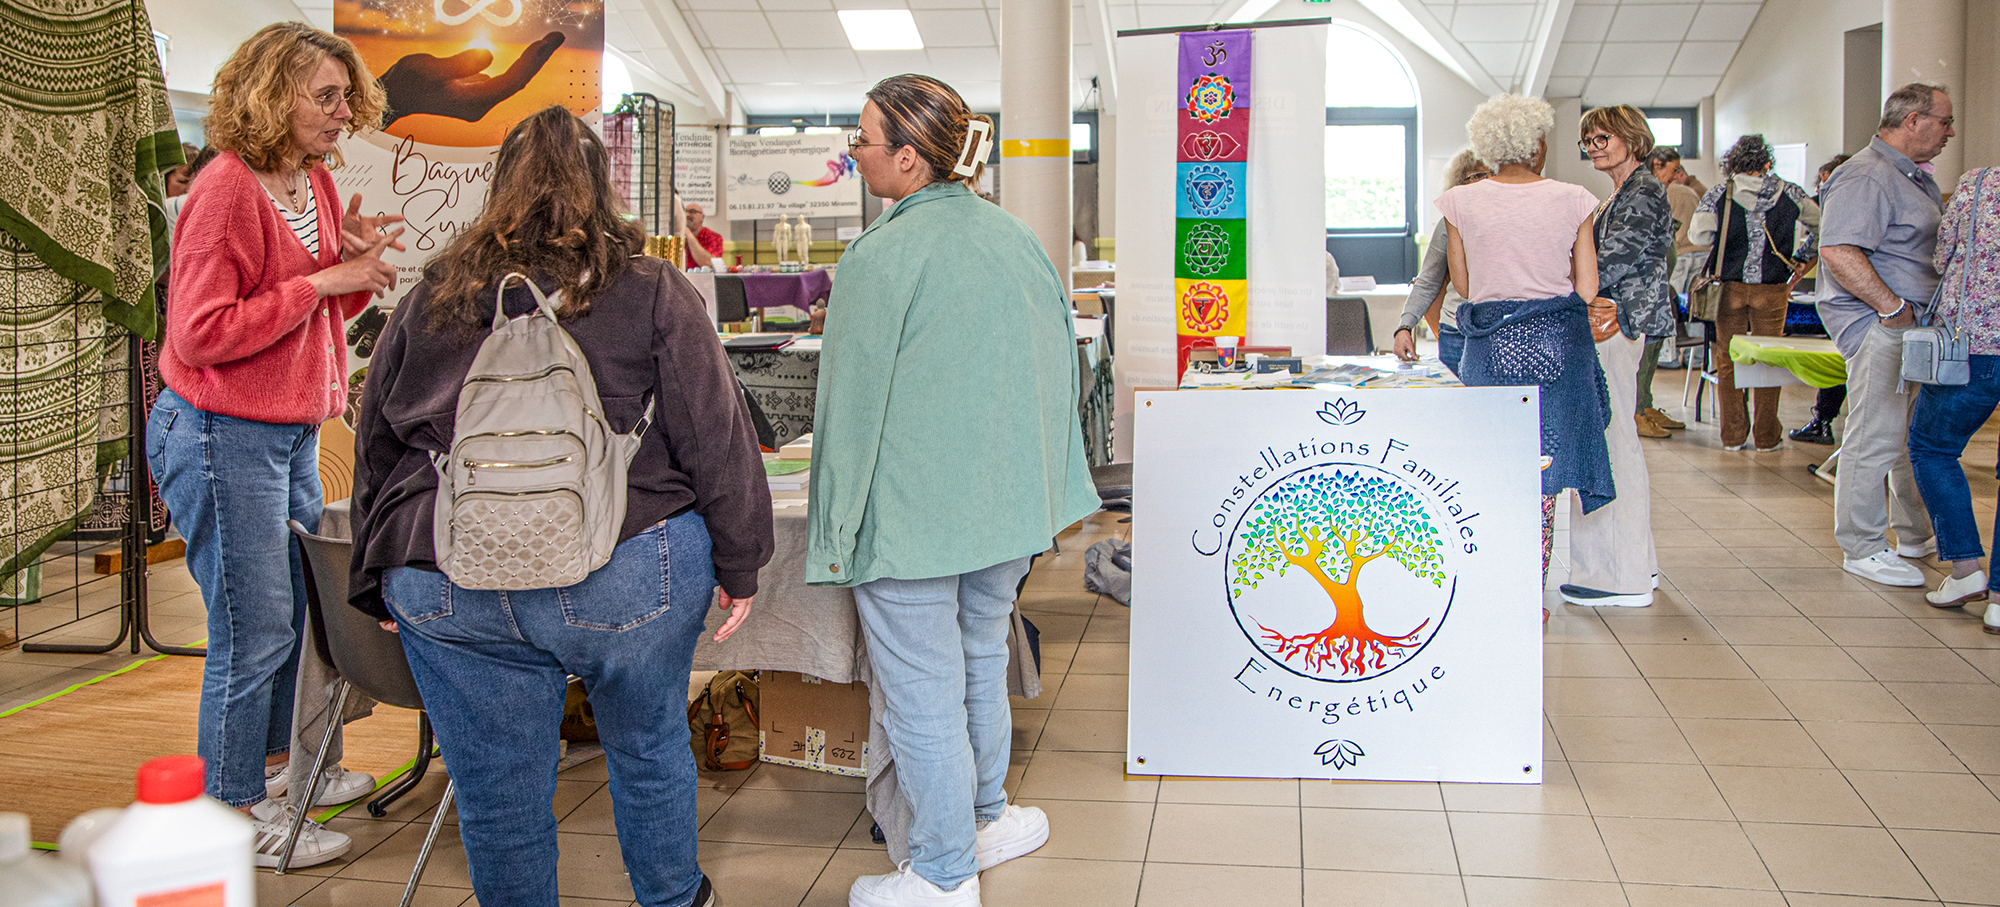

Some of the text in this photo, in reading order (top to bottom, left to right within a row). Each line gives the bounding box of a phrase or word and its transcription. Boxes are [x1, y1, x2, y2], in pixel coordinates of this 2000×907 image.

[729, 140, 757, 148] Philippe
[729, 146, 830, 157] Biomagnétiseur synergique
[1192, 438, 1480, 556] Constellations Familiales
[1233, 656, 1446, 725] Energétique
